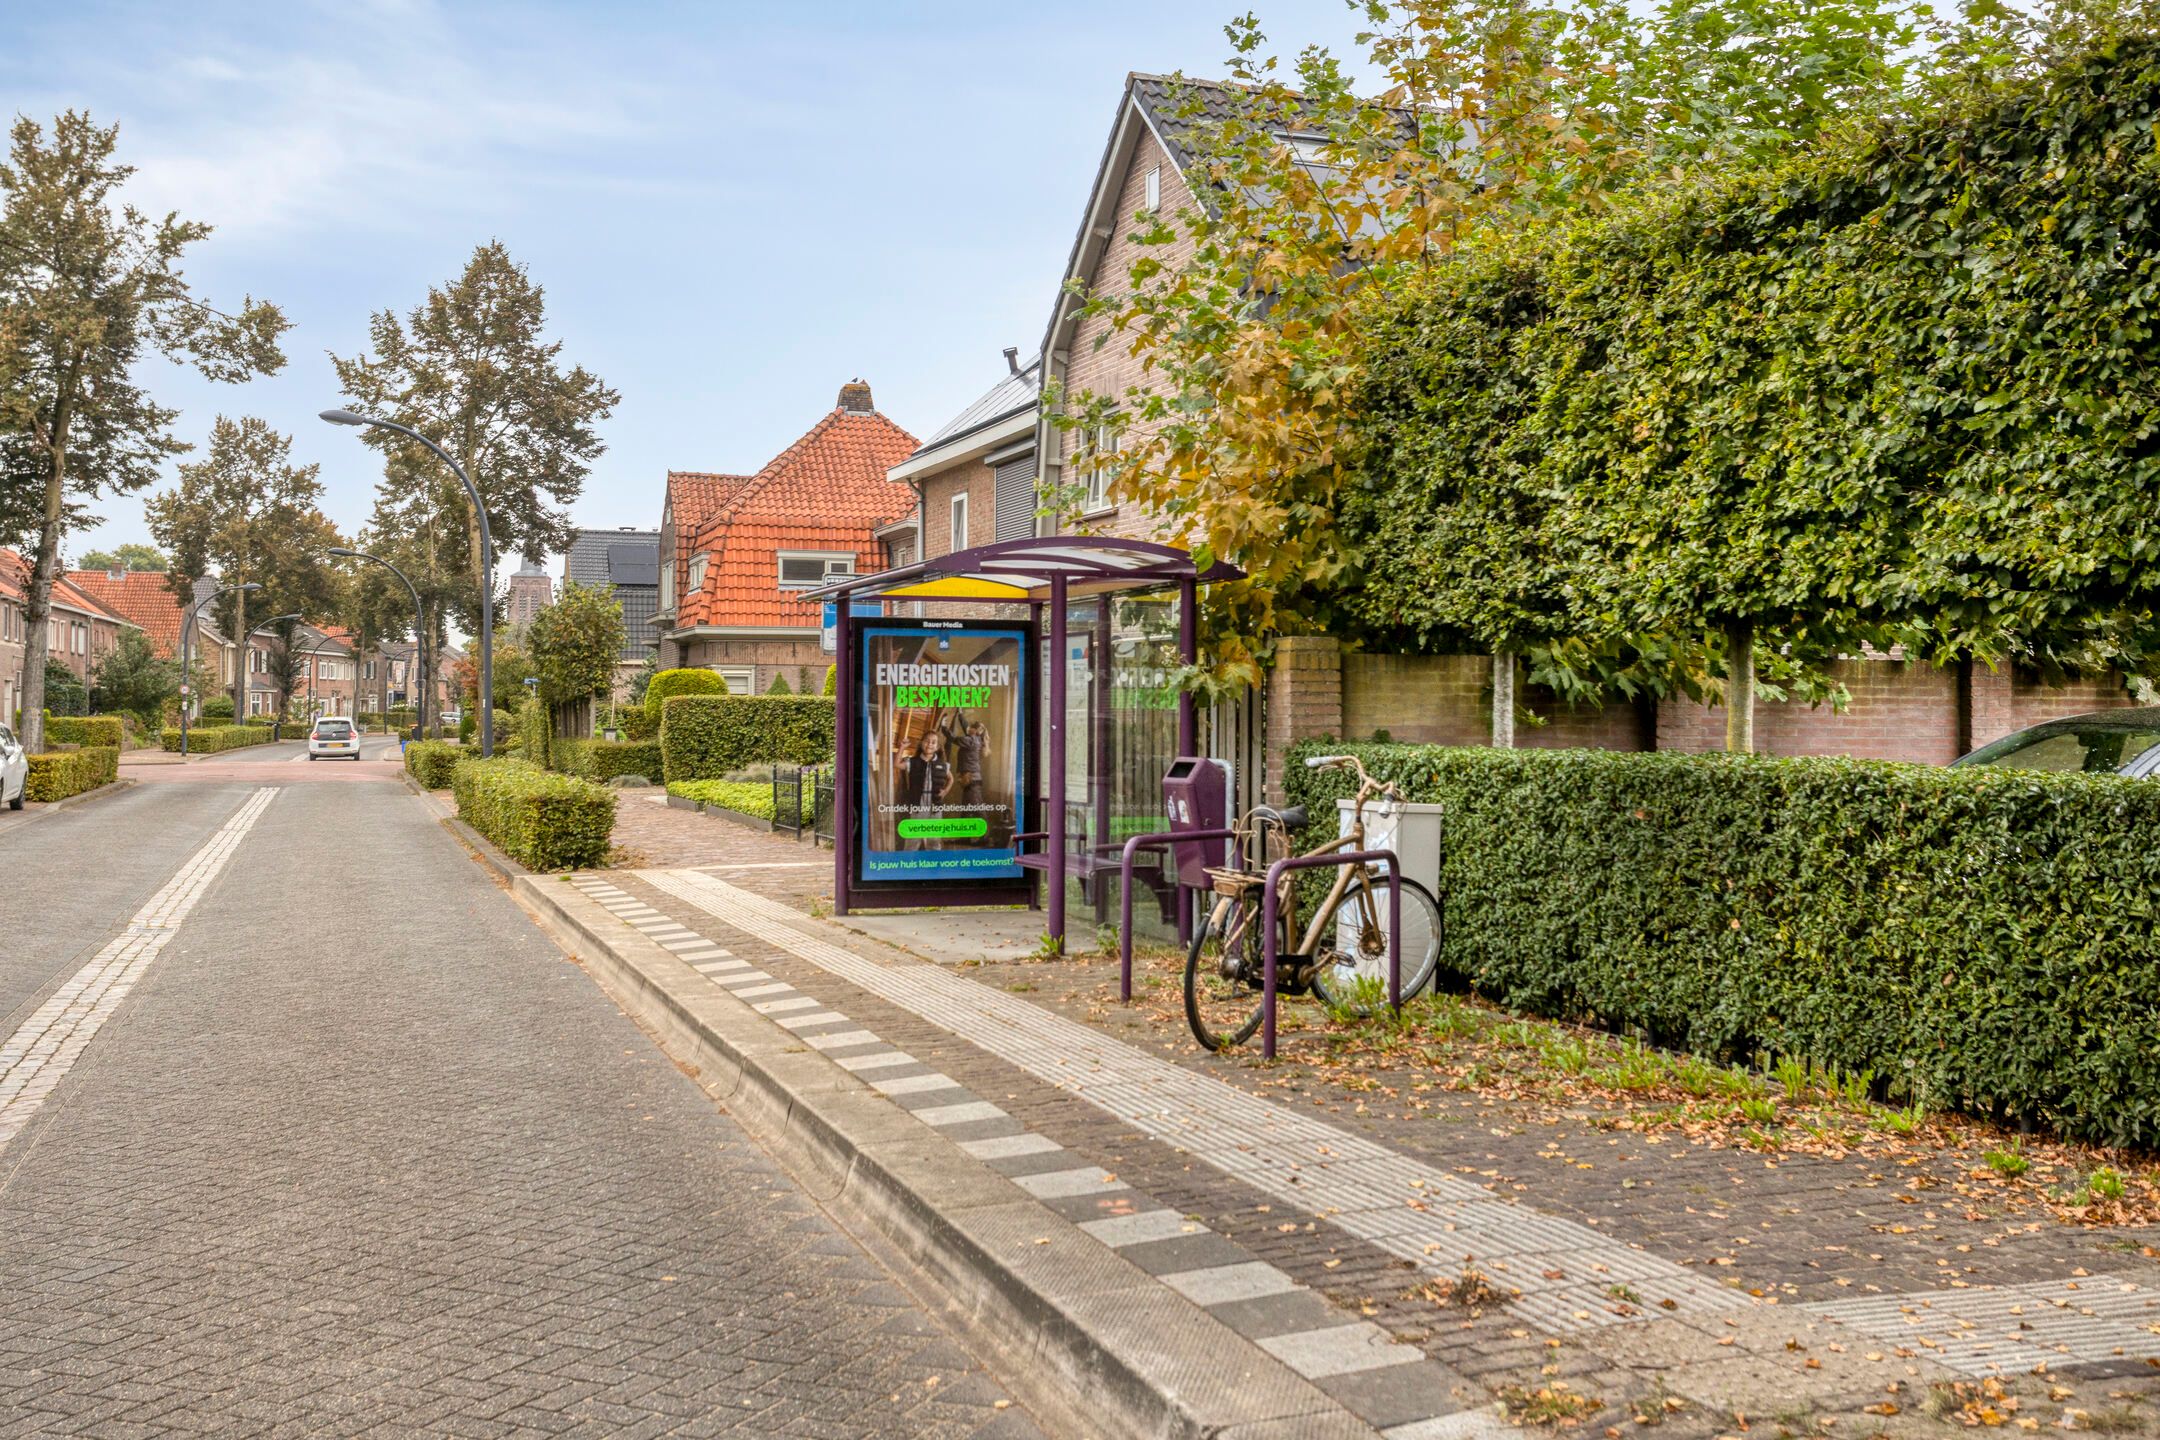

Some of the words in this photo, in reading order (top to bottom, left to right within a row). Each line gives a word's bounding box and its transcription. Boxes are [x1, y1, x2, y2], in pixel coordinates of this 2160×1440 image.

[876, 663, 1009, 686] ENERGIEKOSTEN
[896, 686, 992, 708] BESPAREN?
[878, 804, 909, 813] Ontdek
[909, 804, 931, 813] jouw
[932, 803, 994, 813] isolatiesubsidies
[995, 803, 1007, 813] op
[908, 823, 977, 834] verbeterjehuis.nl
[869, 861, 876, 869] Is
[877, 861, 899, 870] jouw
[900, 860, 917, 869] huis
[918, 859, 938, 868] klaar
[939, 860, 959, 868] voor
[960, 859, 971, 867] de
[972, 857, 1014, 867] toekomst?
